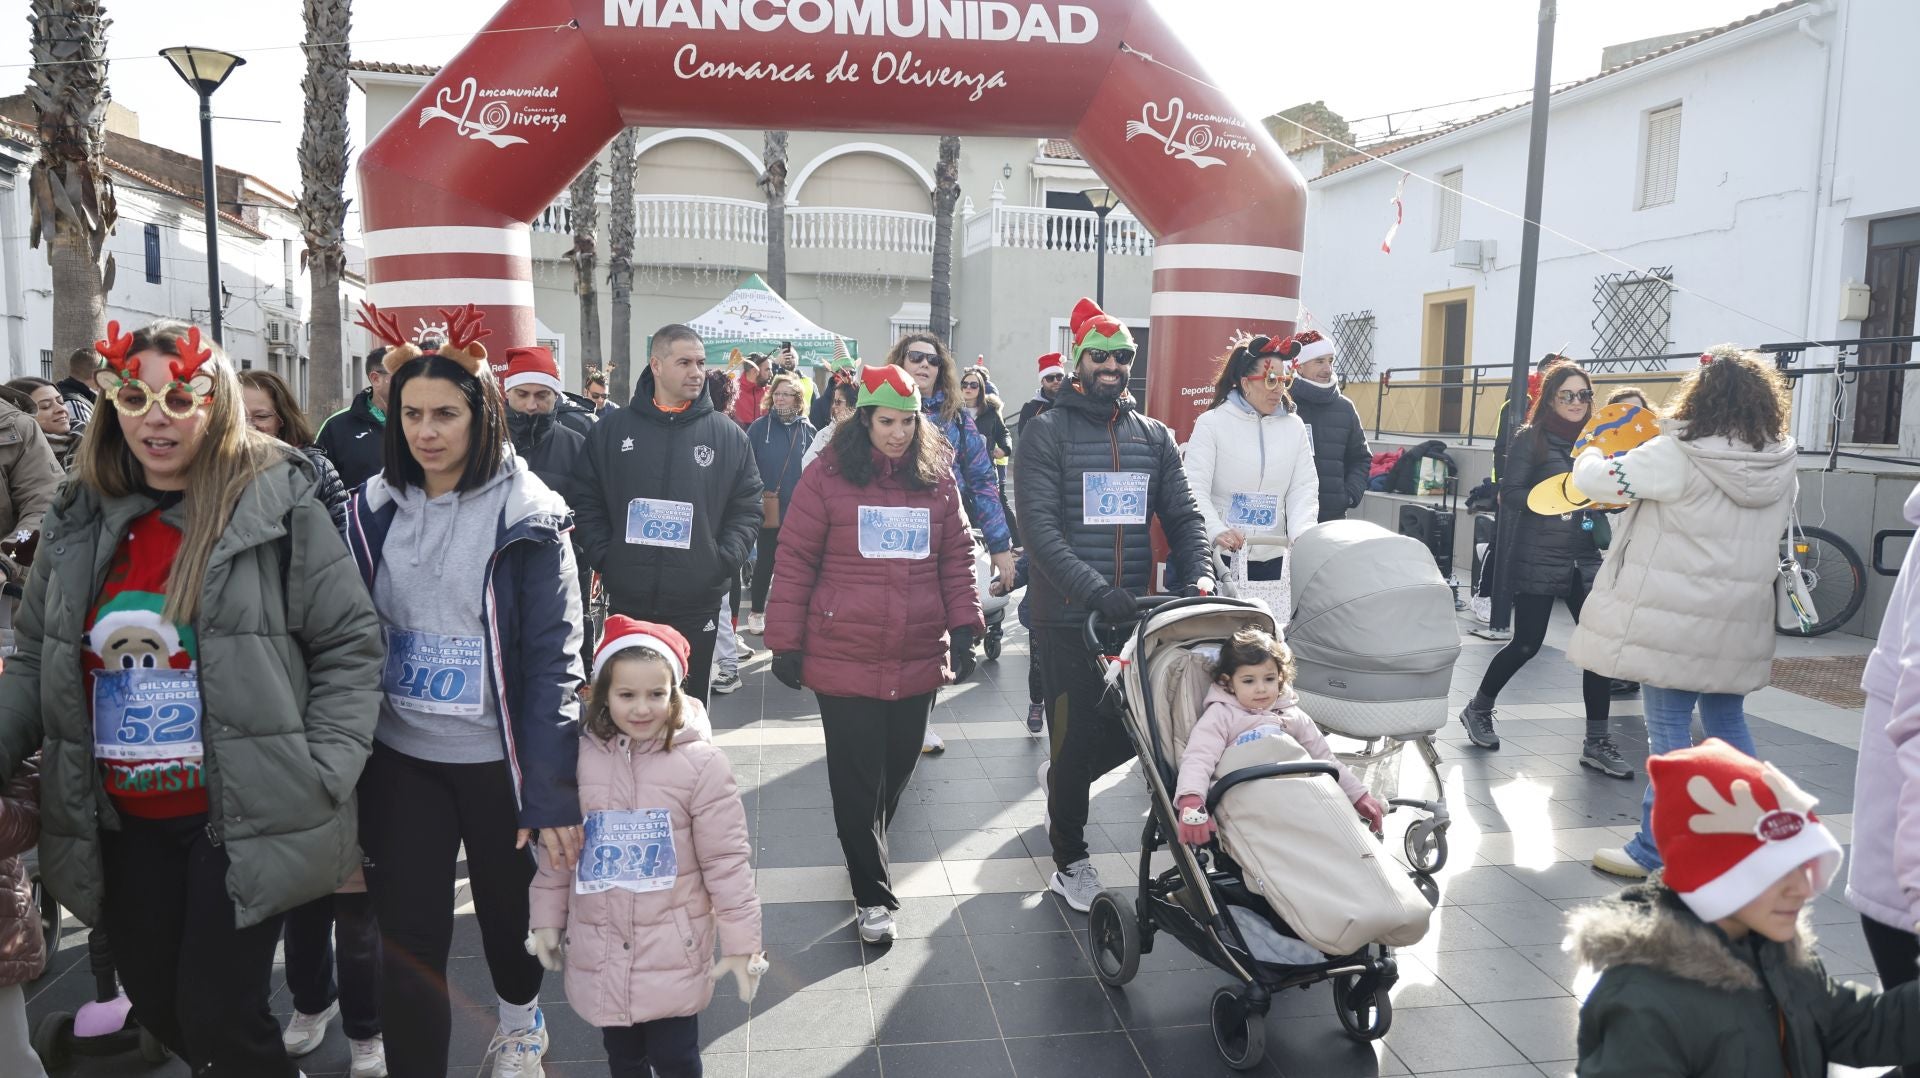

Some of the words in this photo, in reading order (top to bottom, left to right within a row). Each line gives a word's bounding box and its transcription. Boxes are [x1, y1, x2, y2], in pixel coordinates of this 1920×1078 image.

[604, 0, 1099, 44] MANCOMUNIDAD
[673, 44, 815, 81] Comarca
[826, 49, 860, 83] de
[872, 51, 1007, 102] Olivenza
[1098, 492, 1139, 516] 92
[1238, 507, 1273, 528] 43
[642, 518, 684, 541] 63
[880, 528, 918, 551] 91
[455, 640, 481, 648] SAN
[398, 661, 467, 702] 40
[116, 702, 198, 745] 52
[591, 842, 662, 880] 84
